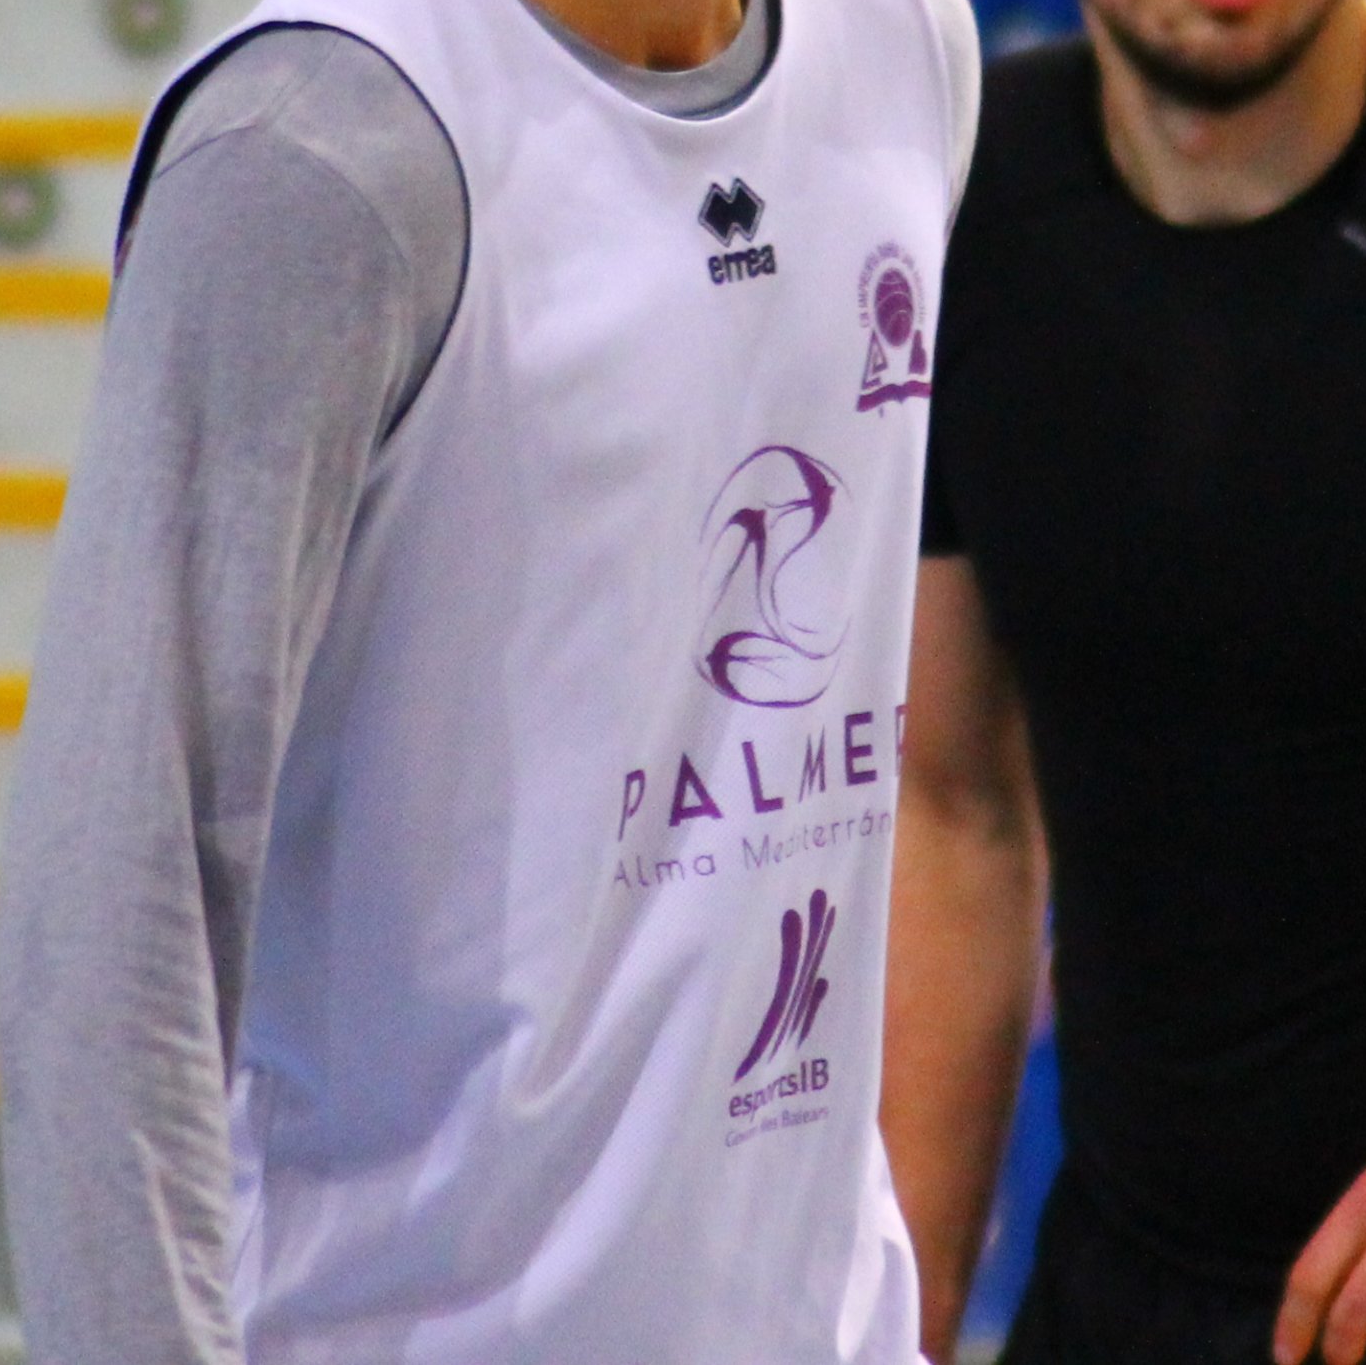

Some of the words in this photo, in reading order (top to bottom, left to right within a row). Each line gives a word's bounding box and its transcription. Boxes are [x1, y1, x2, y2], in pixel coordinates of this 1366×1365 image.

[708, 244, 776, 285] errea
[614, 855, 716, 889] Alma
[742, 808, 891, 870] Medterrán
